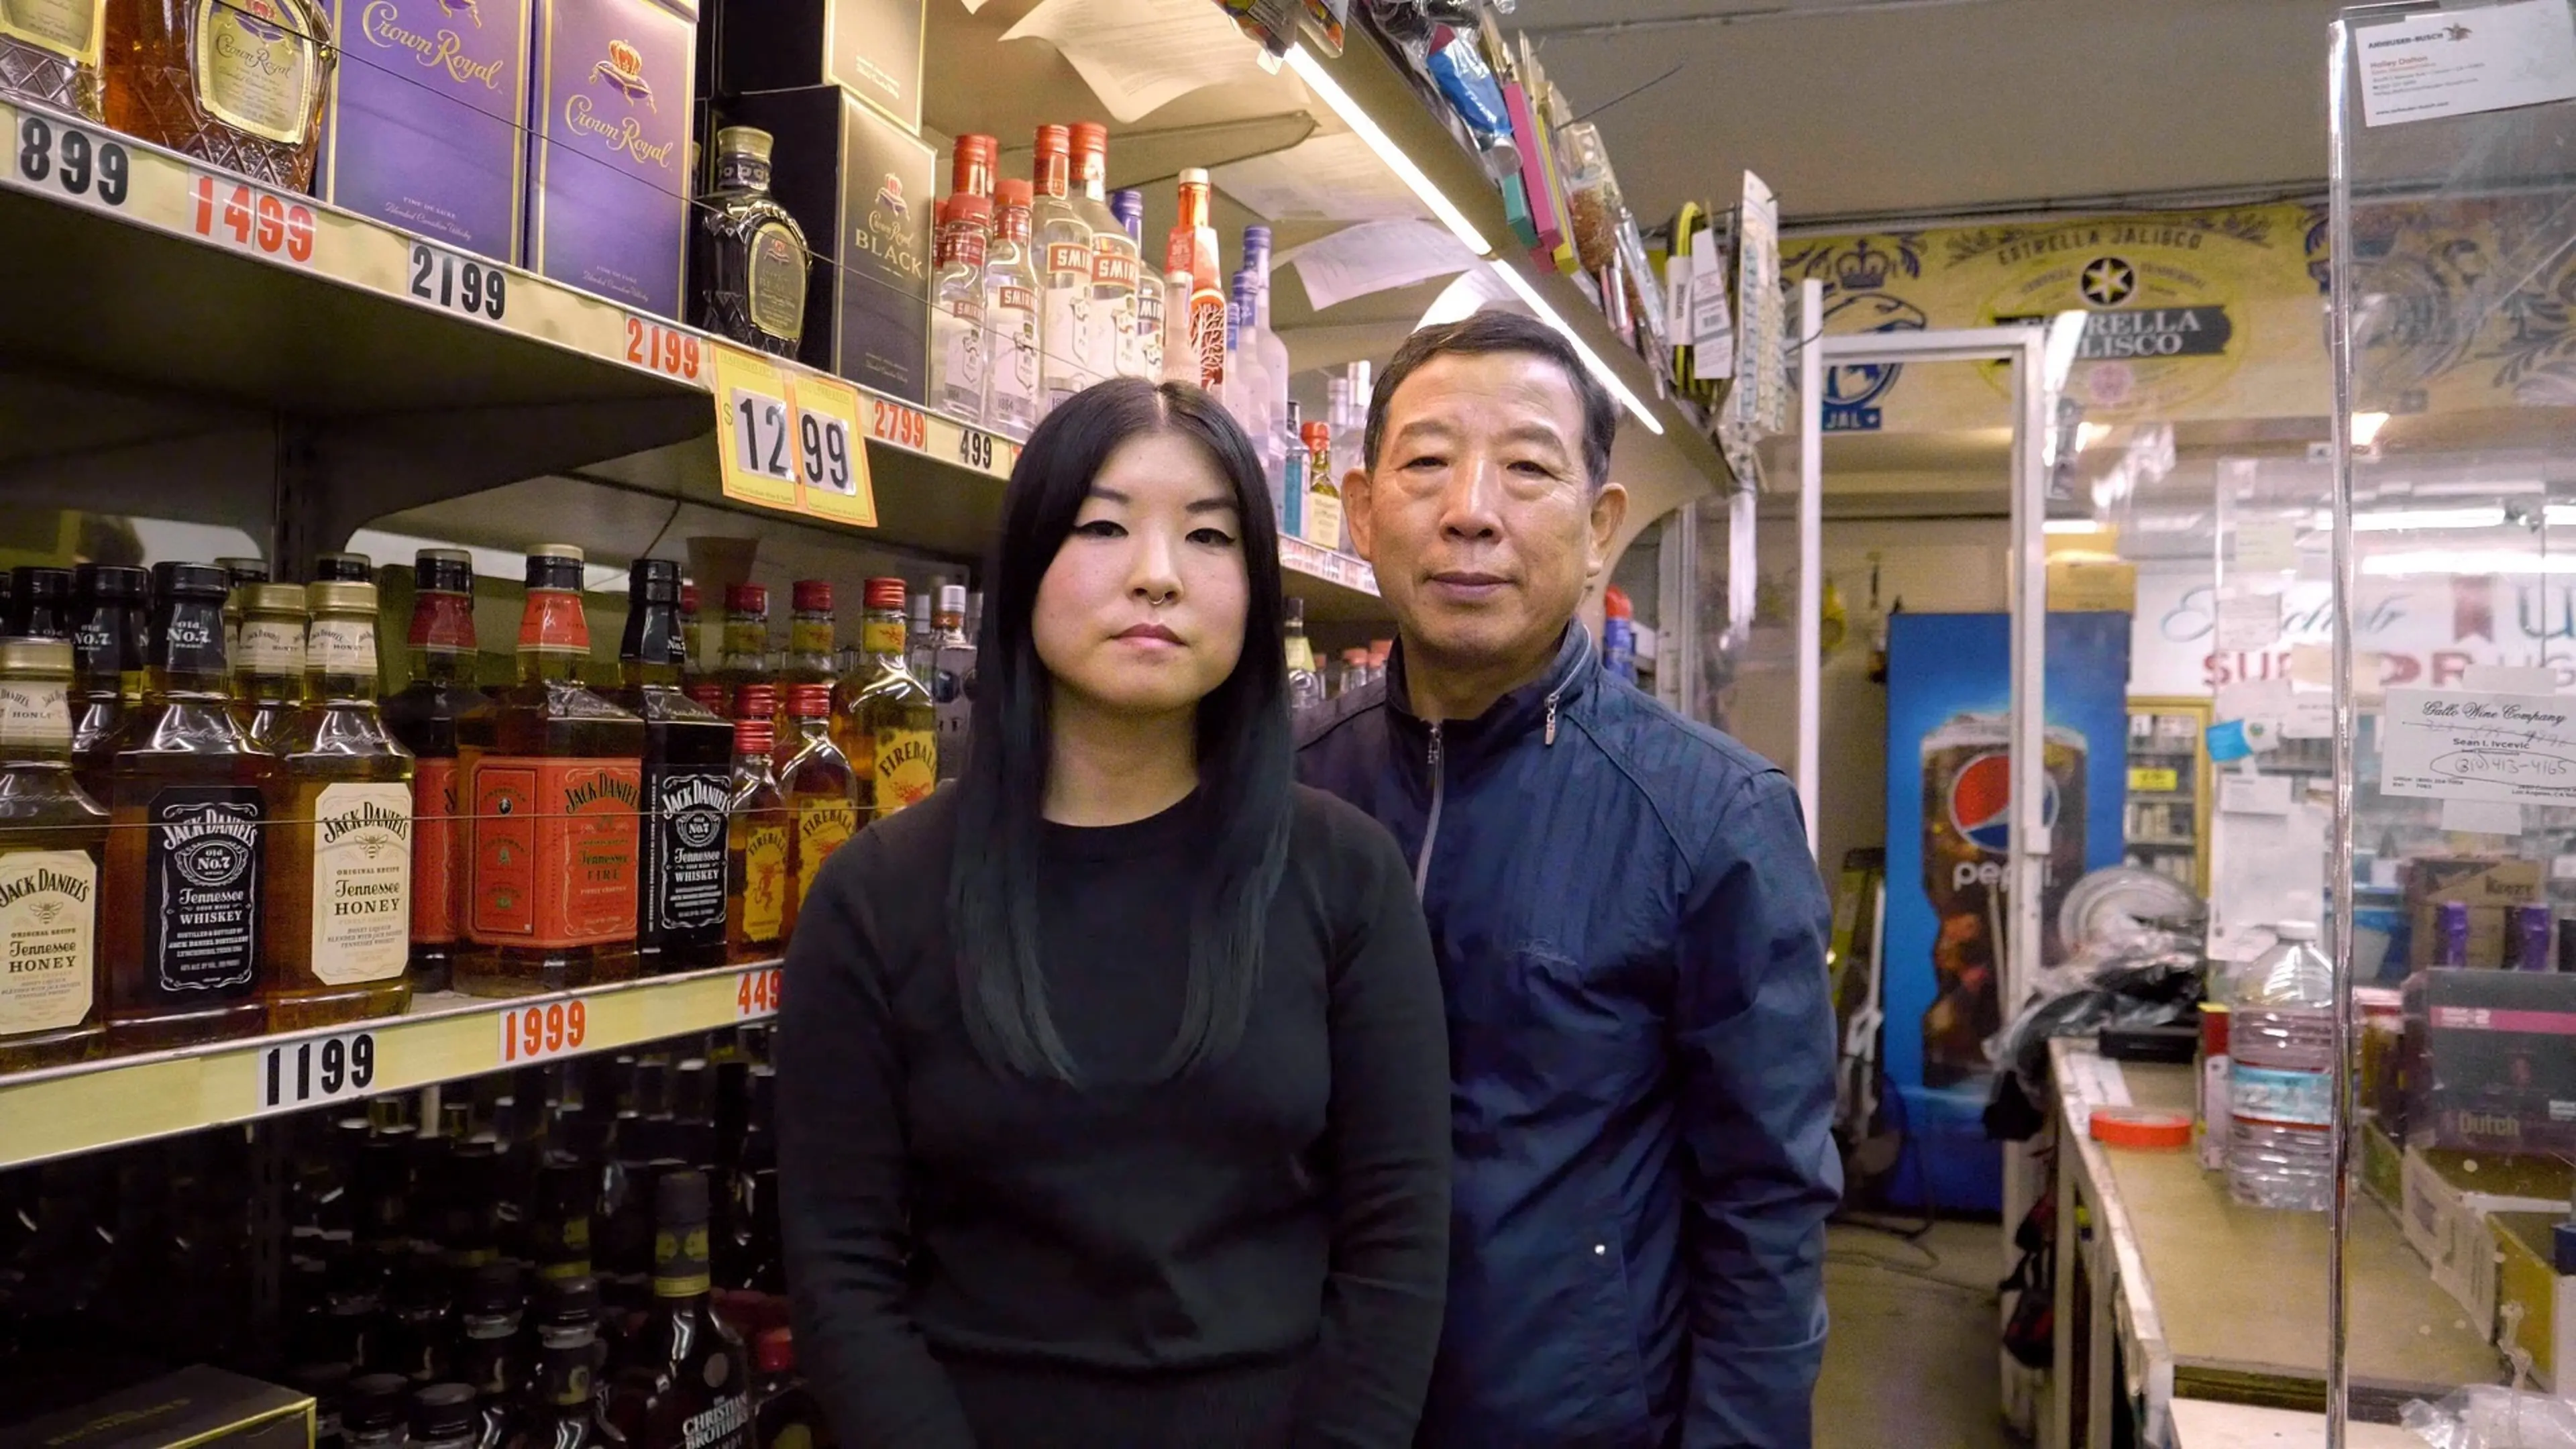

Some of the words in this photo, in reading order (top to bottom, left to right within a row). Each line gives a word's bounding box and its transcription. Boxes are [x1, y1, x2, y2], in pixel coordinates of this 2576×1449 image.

[216, 33, 254, 62] Crown
[362, 1, 431, 56] Crown
[416, 30, 503, 90] Royal
[565, 95, 619, 143] Crown
[606, 116, 673, 168] Royal
[20, 116, 129, 205] 899
[195, 175, 313, 262] 1499
[855, 228, 924, 279] BLACK
[1998, 228, 2100, 266] ESTRELLA
[2110, 226, 2203, 251] JALISCO
[412, 246, 505, 321] 2199
[627, 317, 700, 379] 2199
[2080, 334, 2183, 358] LISCO
[874, 400, 925, 447] 2799
[723, 402, 733, 426] $
[740, 398, 790, 476] 12
[802, 414, 849, 489] 99
[960, 430, 992, 469] 499
[73, 633, 112, 645] No.7
[166, 629, 213, 643] No.7
[2422, 700, 2459, 718] Gallo
[2463, 701, 2498, 720] Wine
[2502, 704, 2567, 727] Company
[2453, 738, 2480, 747] Sean
[564, 781, 598, 814] JACK
[662, 786, 693, 820] JACK
[693, 779, 731, 818] DANIEL'S
[162, 816, 205, 851] JACK
[205, 808, 258, 849] DANIEL'S
[323, 808, 360, 844] JACK
[363, 801, 410, 841] DANIEL'S
[197, 857, 231, 871] No.7
[674, 847, 720, 863] Tennessee
[0, 874, 36, 909] JACK
[38, 868, 90, 904] DANIEL'S
[335, 879, 400, 898] Tennessee
[674, 869, 719, 883] WHISKEY
[1953, 861, 2055, 893] pepi
[178, 888, 244, 905] Tennessee
[334, 898, 400, 916] HONEY
[179, 910, 243, 925] WHISKEY
[8, 955, 77, 974] HONEY
[9, 940, 76, 957] Tennessee
[505, 1000, 587, 1062] 1999
[266, 1034, 375, 1106] 1199
[682, 1389, 747, 1436] CHRISTIAN
